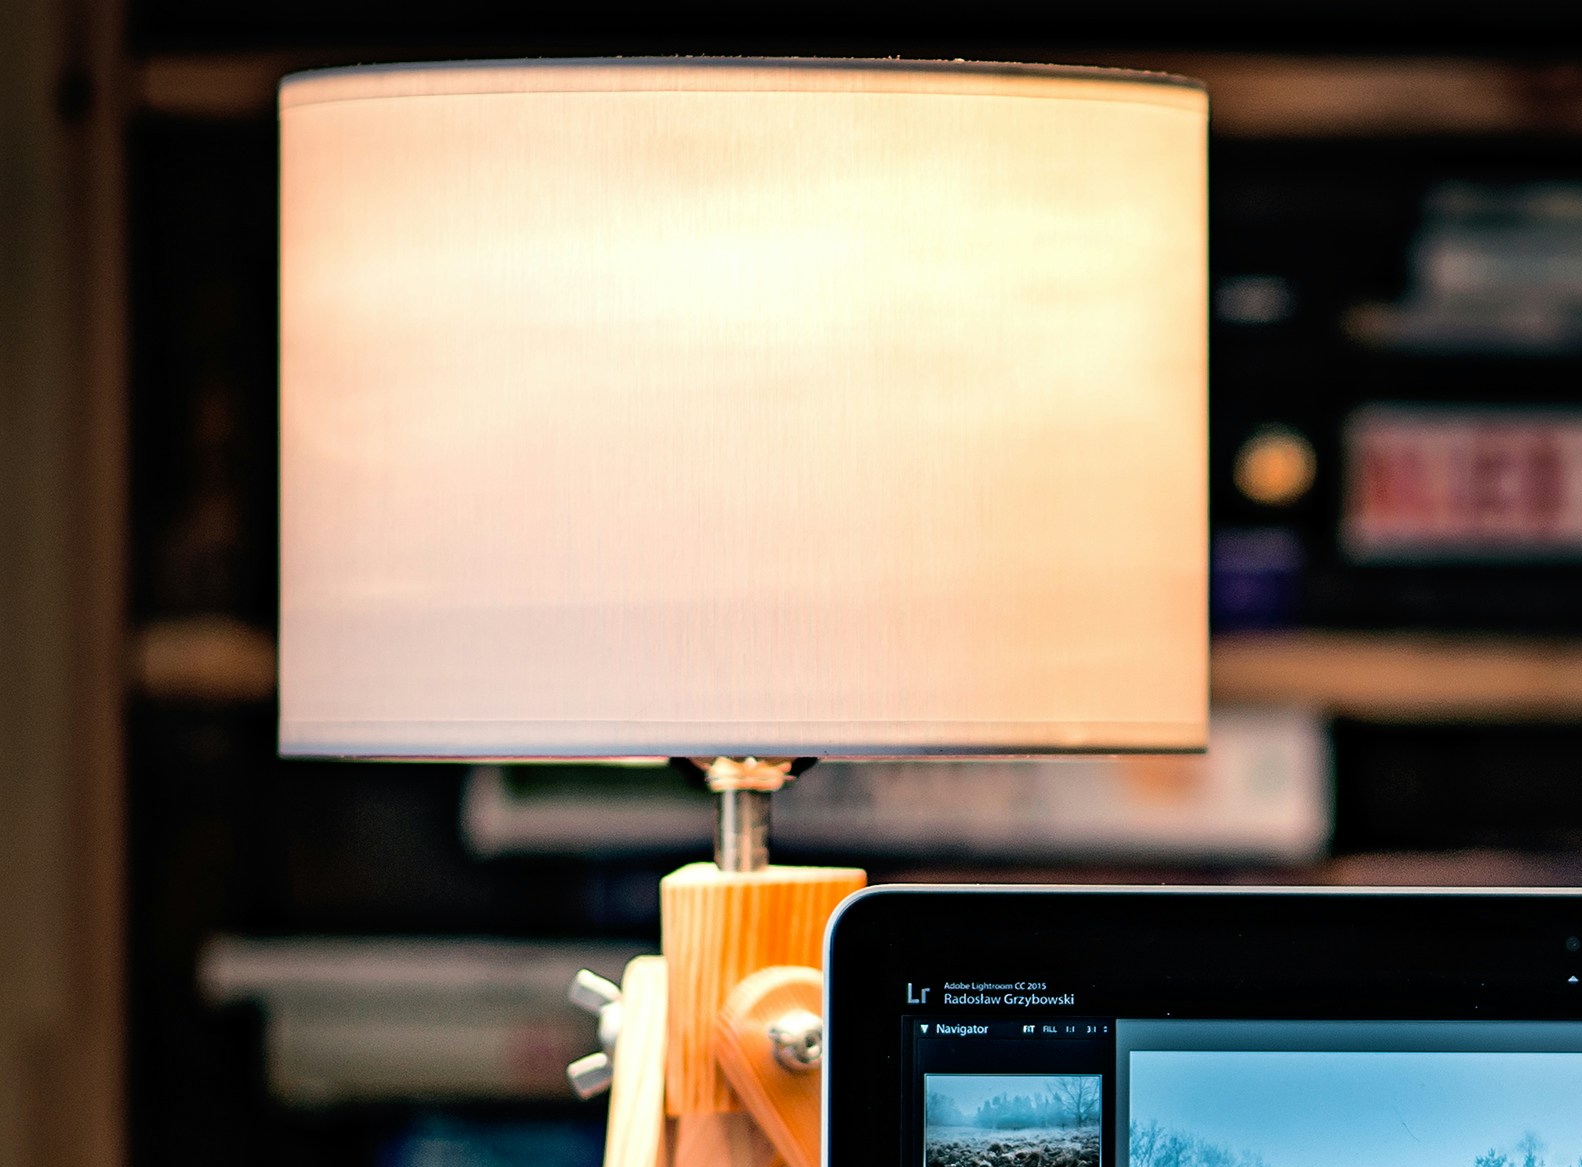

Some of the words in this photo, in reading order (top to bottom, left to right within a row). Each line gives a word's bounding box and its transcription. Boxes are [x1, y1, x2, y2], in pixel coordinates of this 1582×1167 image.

[908, 982, 931, 1003] Lr
[944, 981, 971, 989] Adobe
[972, 981, 1014, 991] Lightroom
[1015, 981, 1026, 990] CC
[1027, 982, 1047, 990] 2015
[945, 993, 1002, 1004] Radosław
[1004, 993, 1075, 1007] Grzybowski
[937, 1023, 989, 1036] Navigator
